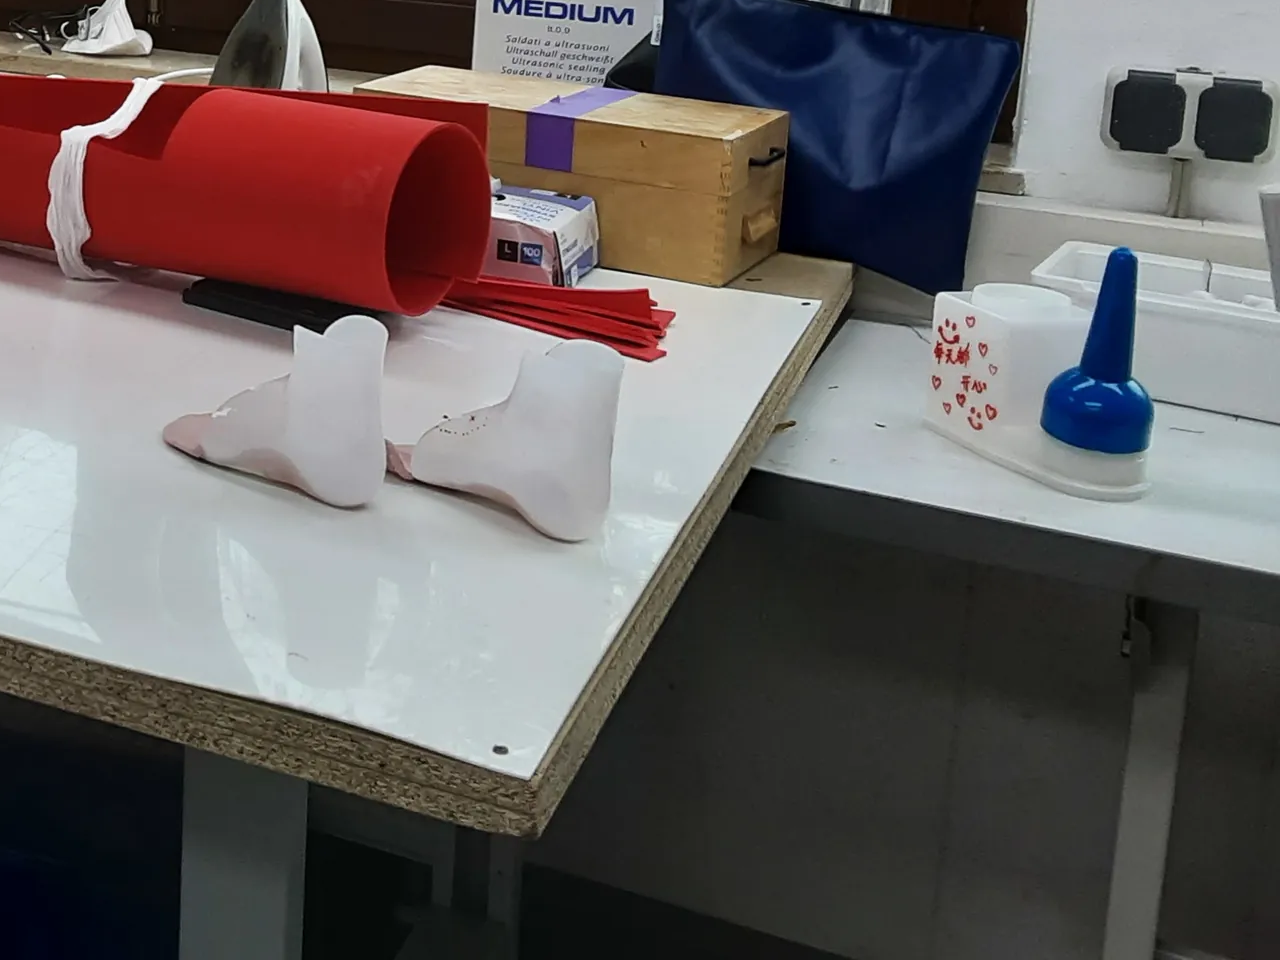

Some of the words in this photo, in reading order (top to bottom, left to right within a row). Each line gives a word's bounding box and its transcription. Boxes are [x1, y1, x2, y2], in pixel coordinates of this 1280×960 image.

[505, 34, 541, 46] Saldati
[554, 40, 610, 52] ultrasuoni
[506, 45, 558, 58] Ultraschall
[560, 52, 614, 65] geschweißt
[500, 66, 542, 78] Soudure
[511, 57, 564, 70] Ultrasonic
[568, 63, 606, 75] sealing
[504, 243, 512, 253] L
[522, 246, 541, 257] 100
[960, 375, 988, 394] 开心
